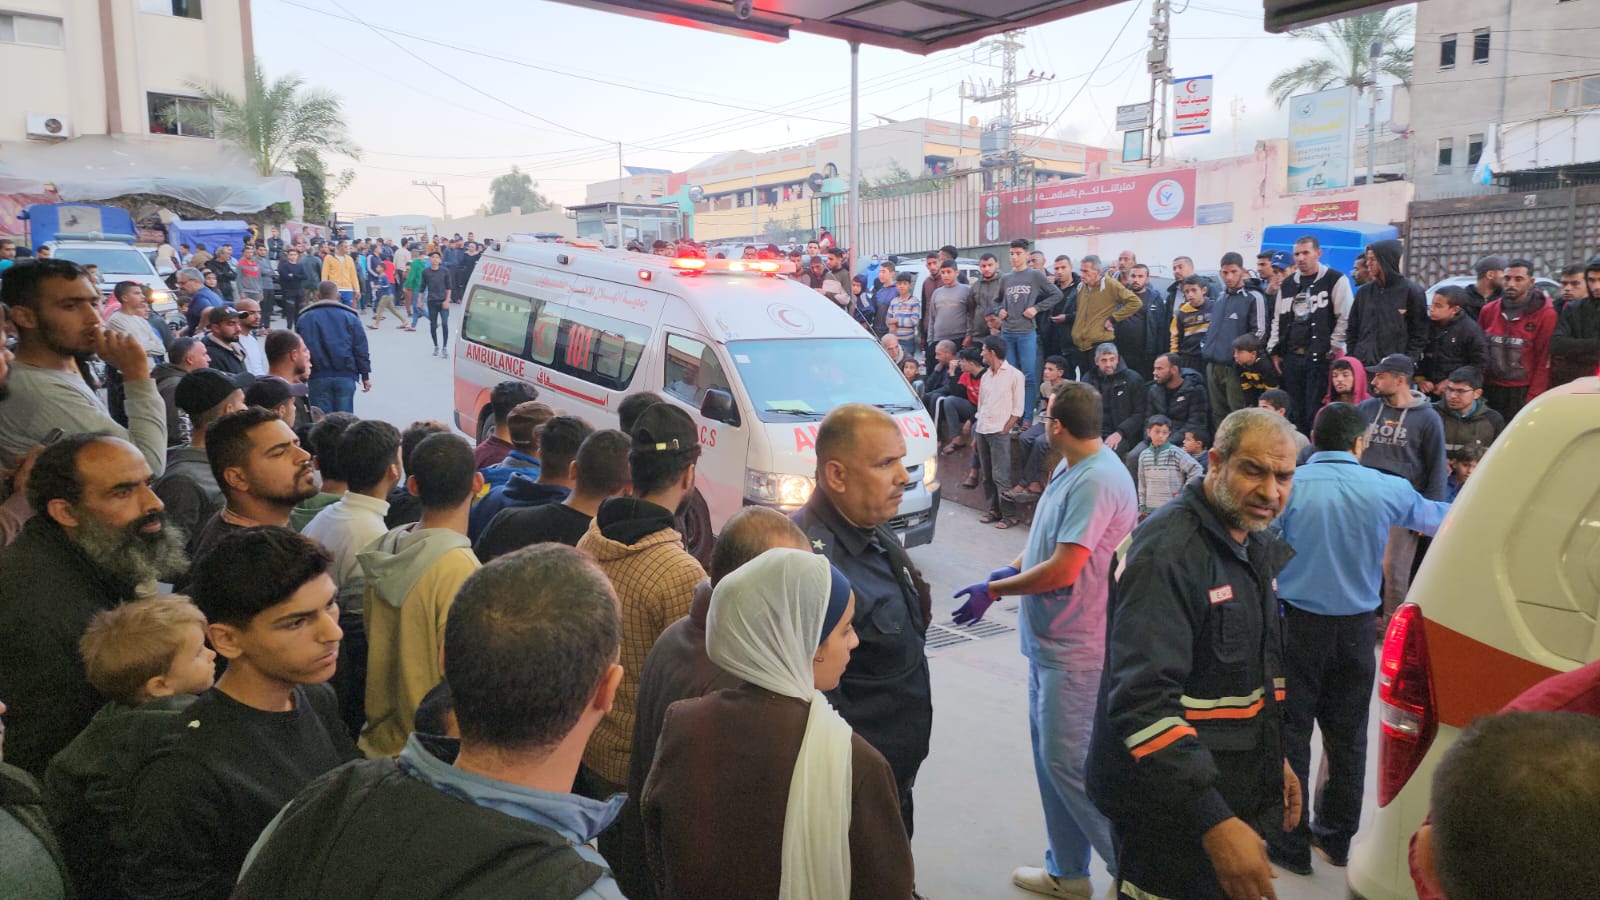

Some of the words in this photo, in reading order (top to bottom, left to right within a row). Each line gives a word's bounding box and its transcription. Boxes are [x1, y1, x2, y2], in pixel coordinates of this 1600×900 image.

[1078, 184, 1099, 199] لكم
[482, 262, 512, 285] 1206
[1007, 285, 1032, 296] GUESS
[566, 323, 594, 370] 101
[466, 343, 526, 377] AMBULANCE
